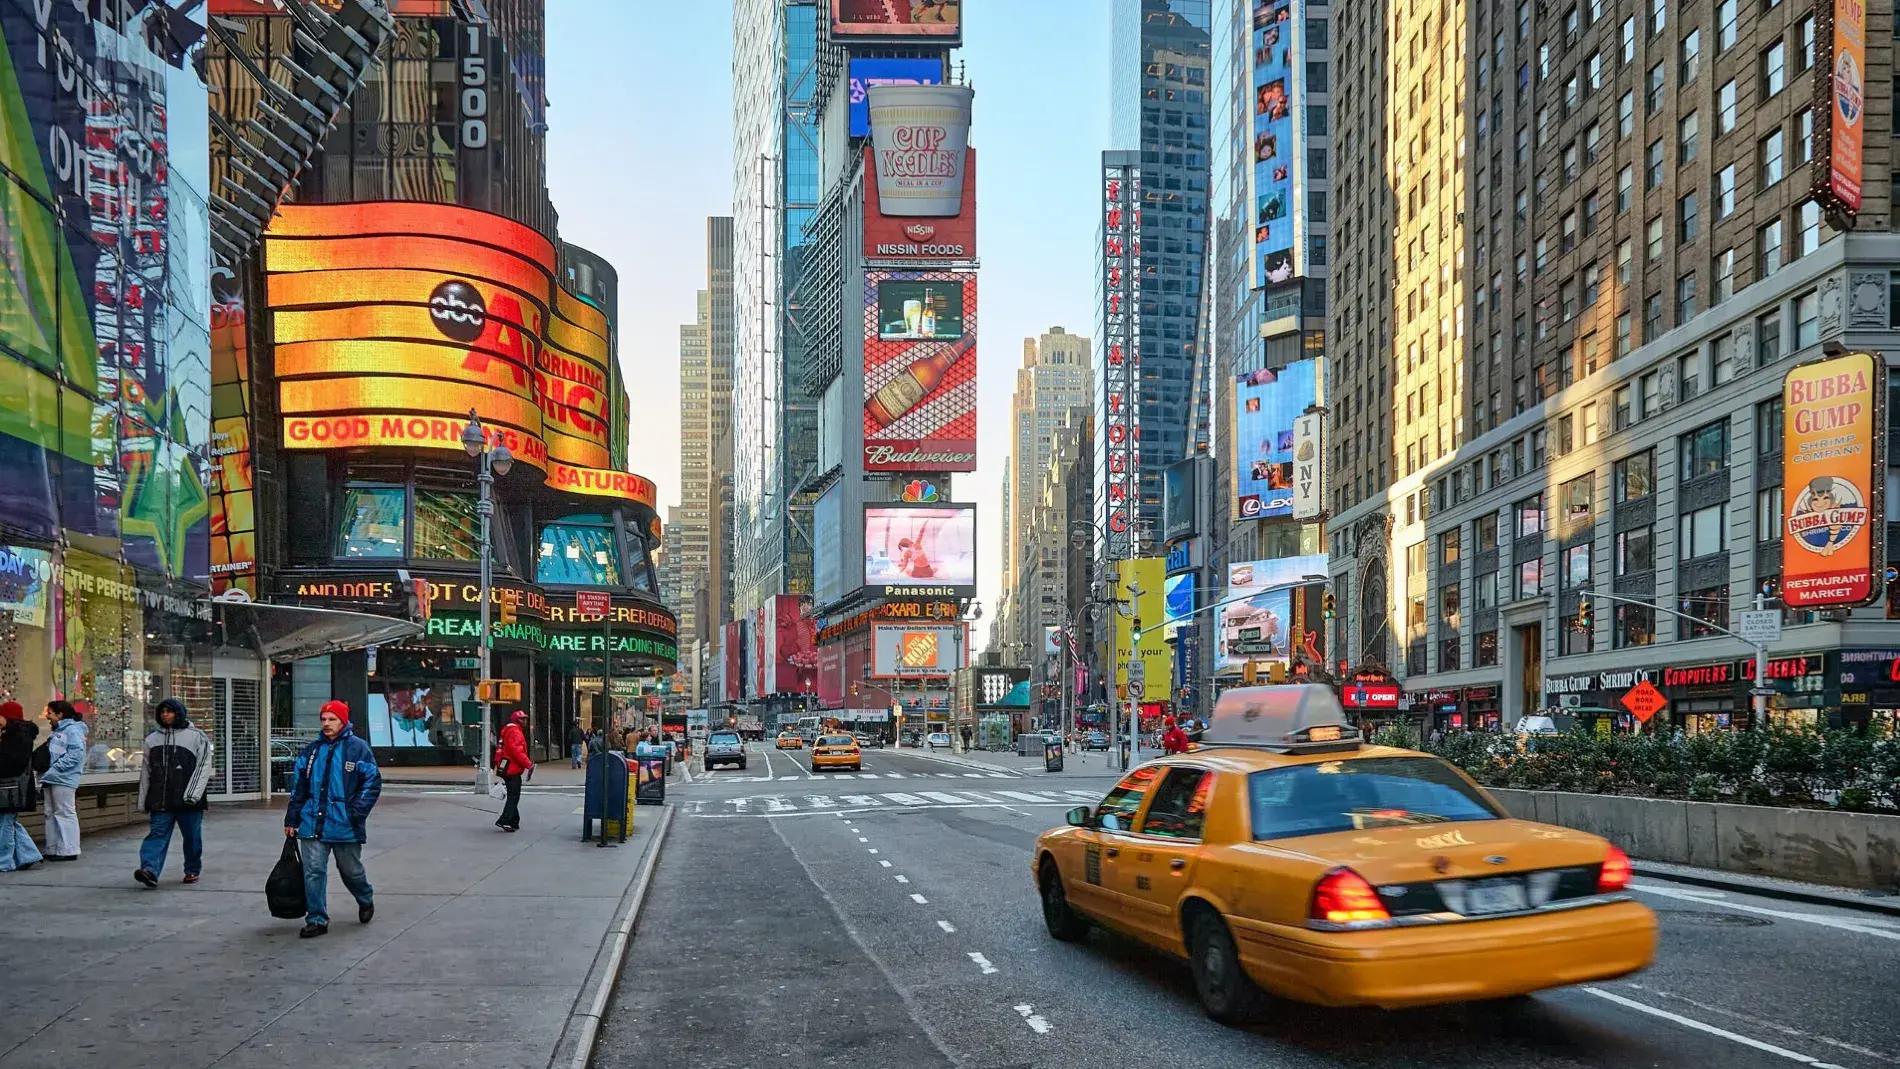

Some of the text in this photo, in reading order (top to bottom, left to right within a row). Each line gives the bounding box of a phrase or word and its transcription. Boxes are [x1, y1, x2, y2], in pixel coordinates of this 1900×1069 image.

[462, 27, 487, 148] 1500
[893, 126, 946, 151] CUP
[881, 150, 958, 178] NOODLES
[907, 225, 934, 235] NISSIN
[877, 244, 963, 255] NISSIN FOODS
[1107, 180, 1123, 314] ERNST
[431, 294, 484, 326] abc
[1789, 369, 1868, 406] BUBBA
[1794, 402, 1862, 435] GUMP
[288, 418, 370, 442] GOOD
[1800, 434, 1856, 452] SHRIMP
[865, 445, 975, 465] Budweiser
[1110, 394, 1127, 533] YOUNG
[1792, 444, 1863, 464] COMPANY
[1262, 497, 1294, 510] LEX
[1790, 509, 1865, 534] BUBBA GUMP
[1801, 526, 1829, 537] SHRIMP
[885, 586, 955, 596] Panasonic
[1786, 573, 1867, 589] RESTAURANT
[71, 569, 94, 593] THE
[97, 577, 141, 604] PERFECT
[144, 591, 161, 609] TOY
[163, 596, 195, 618] BRINGS
[428, 583, 457, 601] OT
[1800, 587, 1852, 601] MARKET
[549, 635, 586, 651] ARE
[592, 636, 652, 656] READING
[904, 633, 938, 667] HOME
[909, 636, 922, 649] THE
[917, 647, 937, 667] DEPOT
[1118, 649, 1126, 657] TV
[1141, 649, 1163, 658] your
[1356, 674, 1384, 683] Hard Rock
[1546, 678, 1568, 693] BUBBA
[1569, 676, 1591, 692] GUMP
[1600, 671, 1633, 690] SHRIMP
[1665, 658, 1808, 686] COMPUTERS CMERAS
